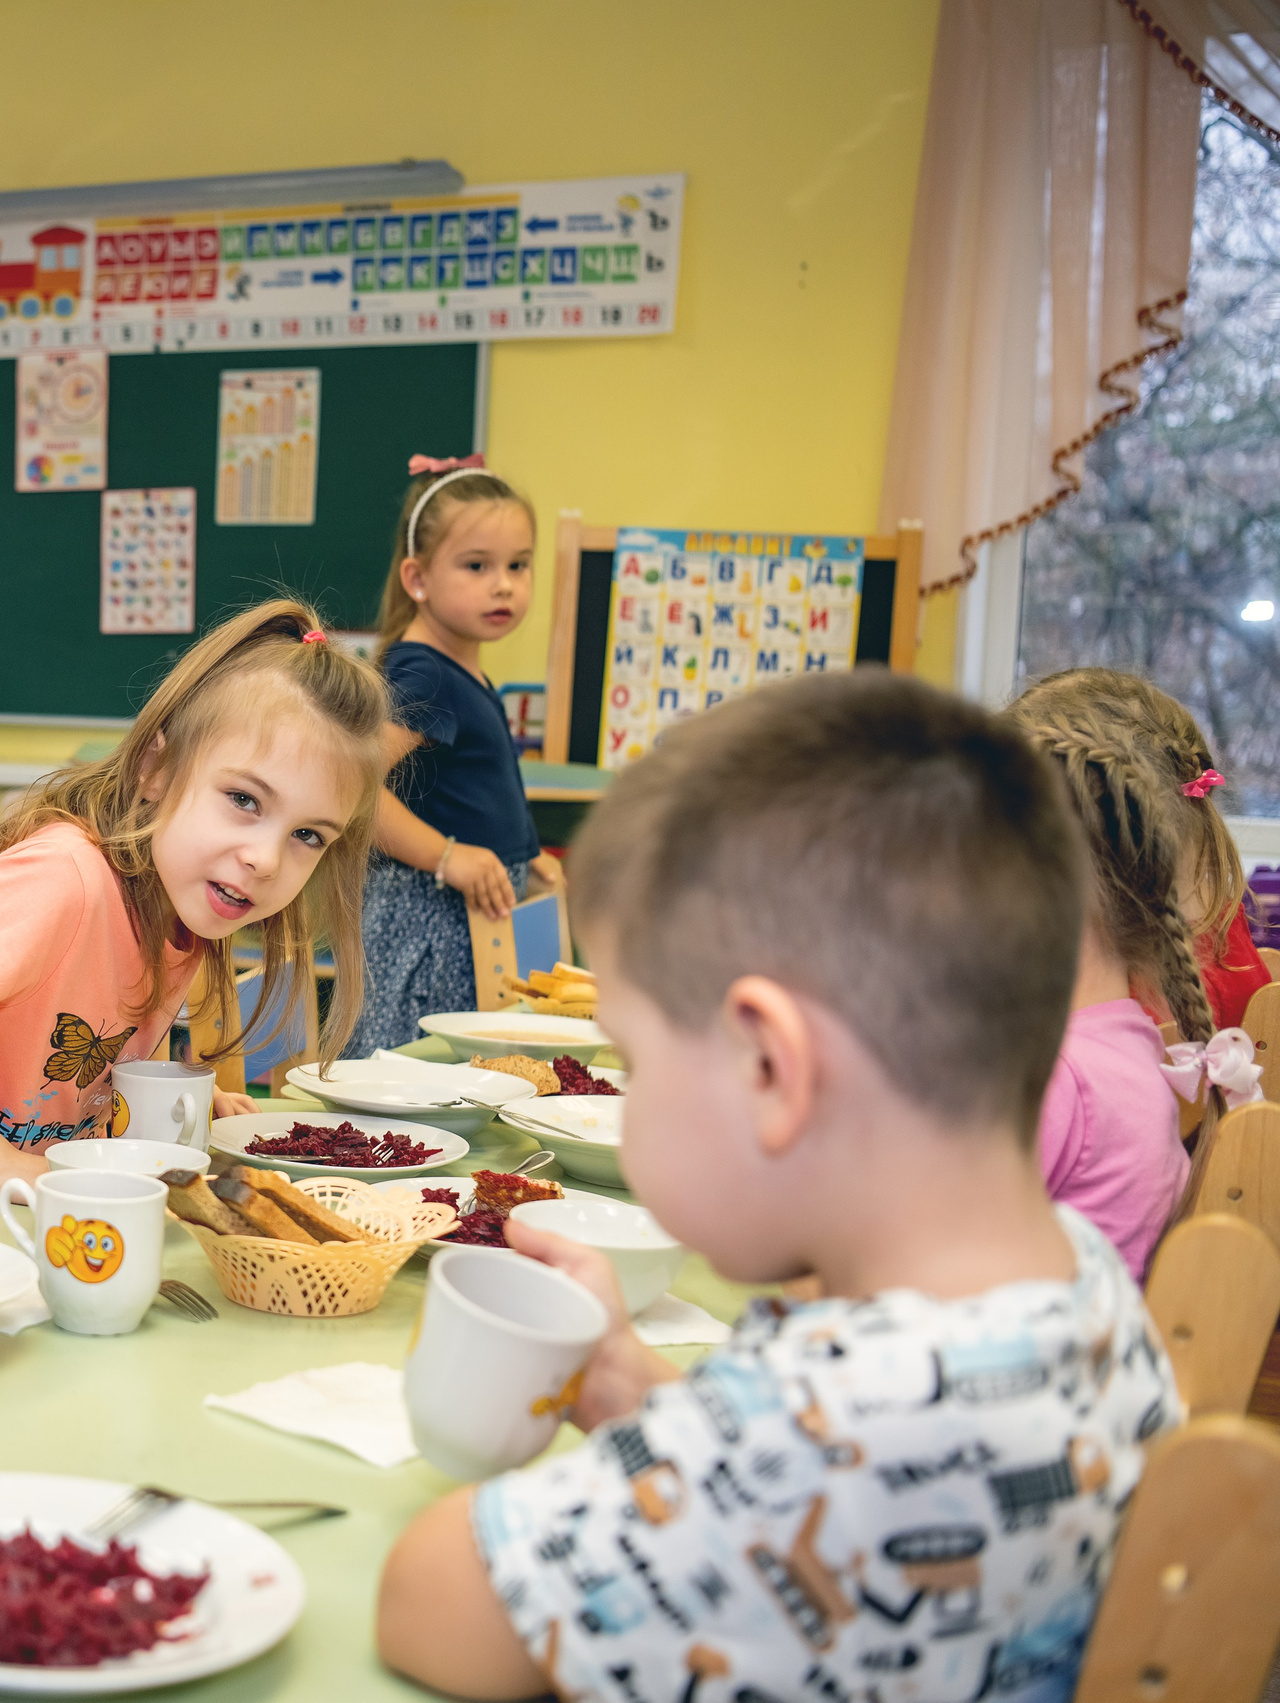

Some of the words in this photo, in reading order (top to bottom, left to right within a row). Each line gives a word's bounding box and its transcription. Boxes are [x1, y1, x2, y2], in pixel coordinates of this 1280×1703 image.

[121, 237, 143, 262] О
[525, 308, 545, 328] 17
[601, 305, 620, 326] 19
[637, 304, 660, 325] 20
[623, 555, 641, 577] А
[670, 558, 687, 580] Б
[718, 560, 735, 582] В
[767, 560, 783, 584] Г
[813, 563, 833, 584] Д
[620, 597, 634, 621] Е
[713, 602, 734, 626] Ж
[764, 605, 780, 629] З
[809, 607, 828, 631] И
[662, 644, 678, 667] К
[711, 647, 729, 670] Л
[757, 650, 779, 672] М
[804, 651, 826, 671] Н
[611, 685, 630, 709] О
[658, 688, 679, 710] П
[705, 690, 723, 709] Р
[611, 729, 627, 753] У
